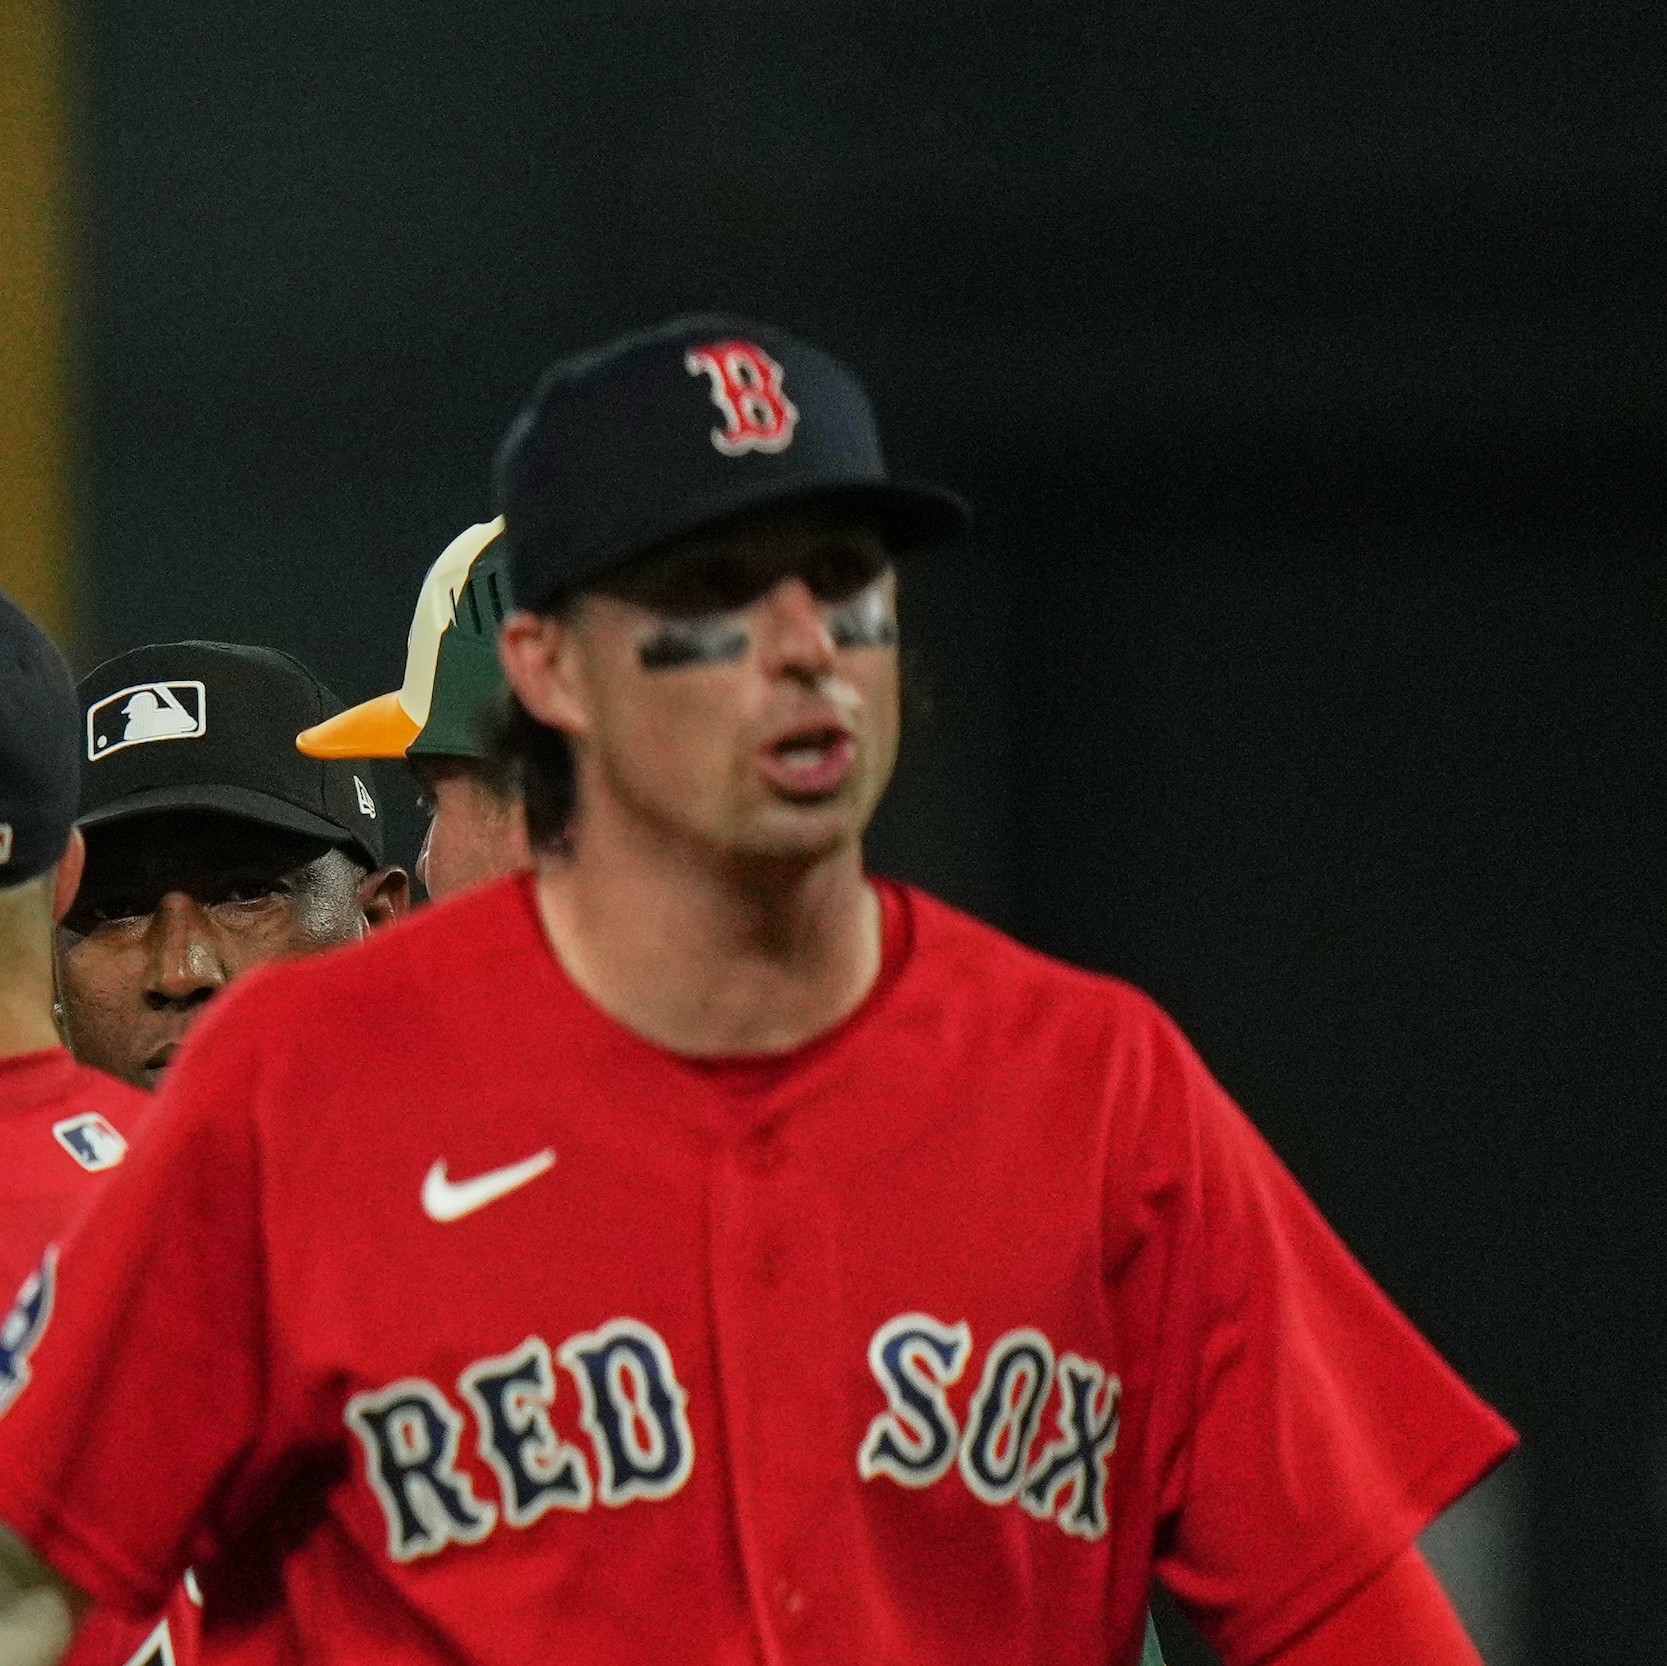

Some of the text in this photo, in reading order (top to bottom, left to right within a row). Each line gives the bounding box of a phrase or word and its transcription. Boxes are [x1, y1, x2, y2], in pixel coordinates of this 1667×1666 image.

[684, 339, 800, 457] B
[344, 1312, 1122, 1561] RED SOX
